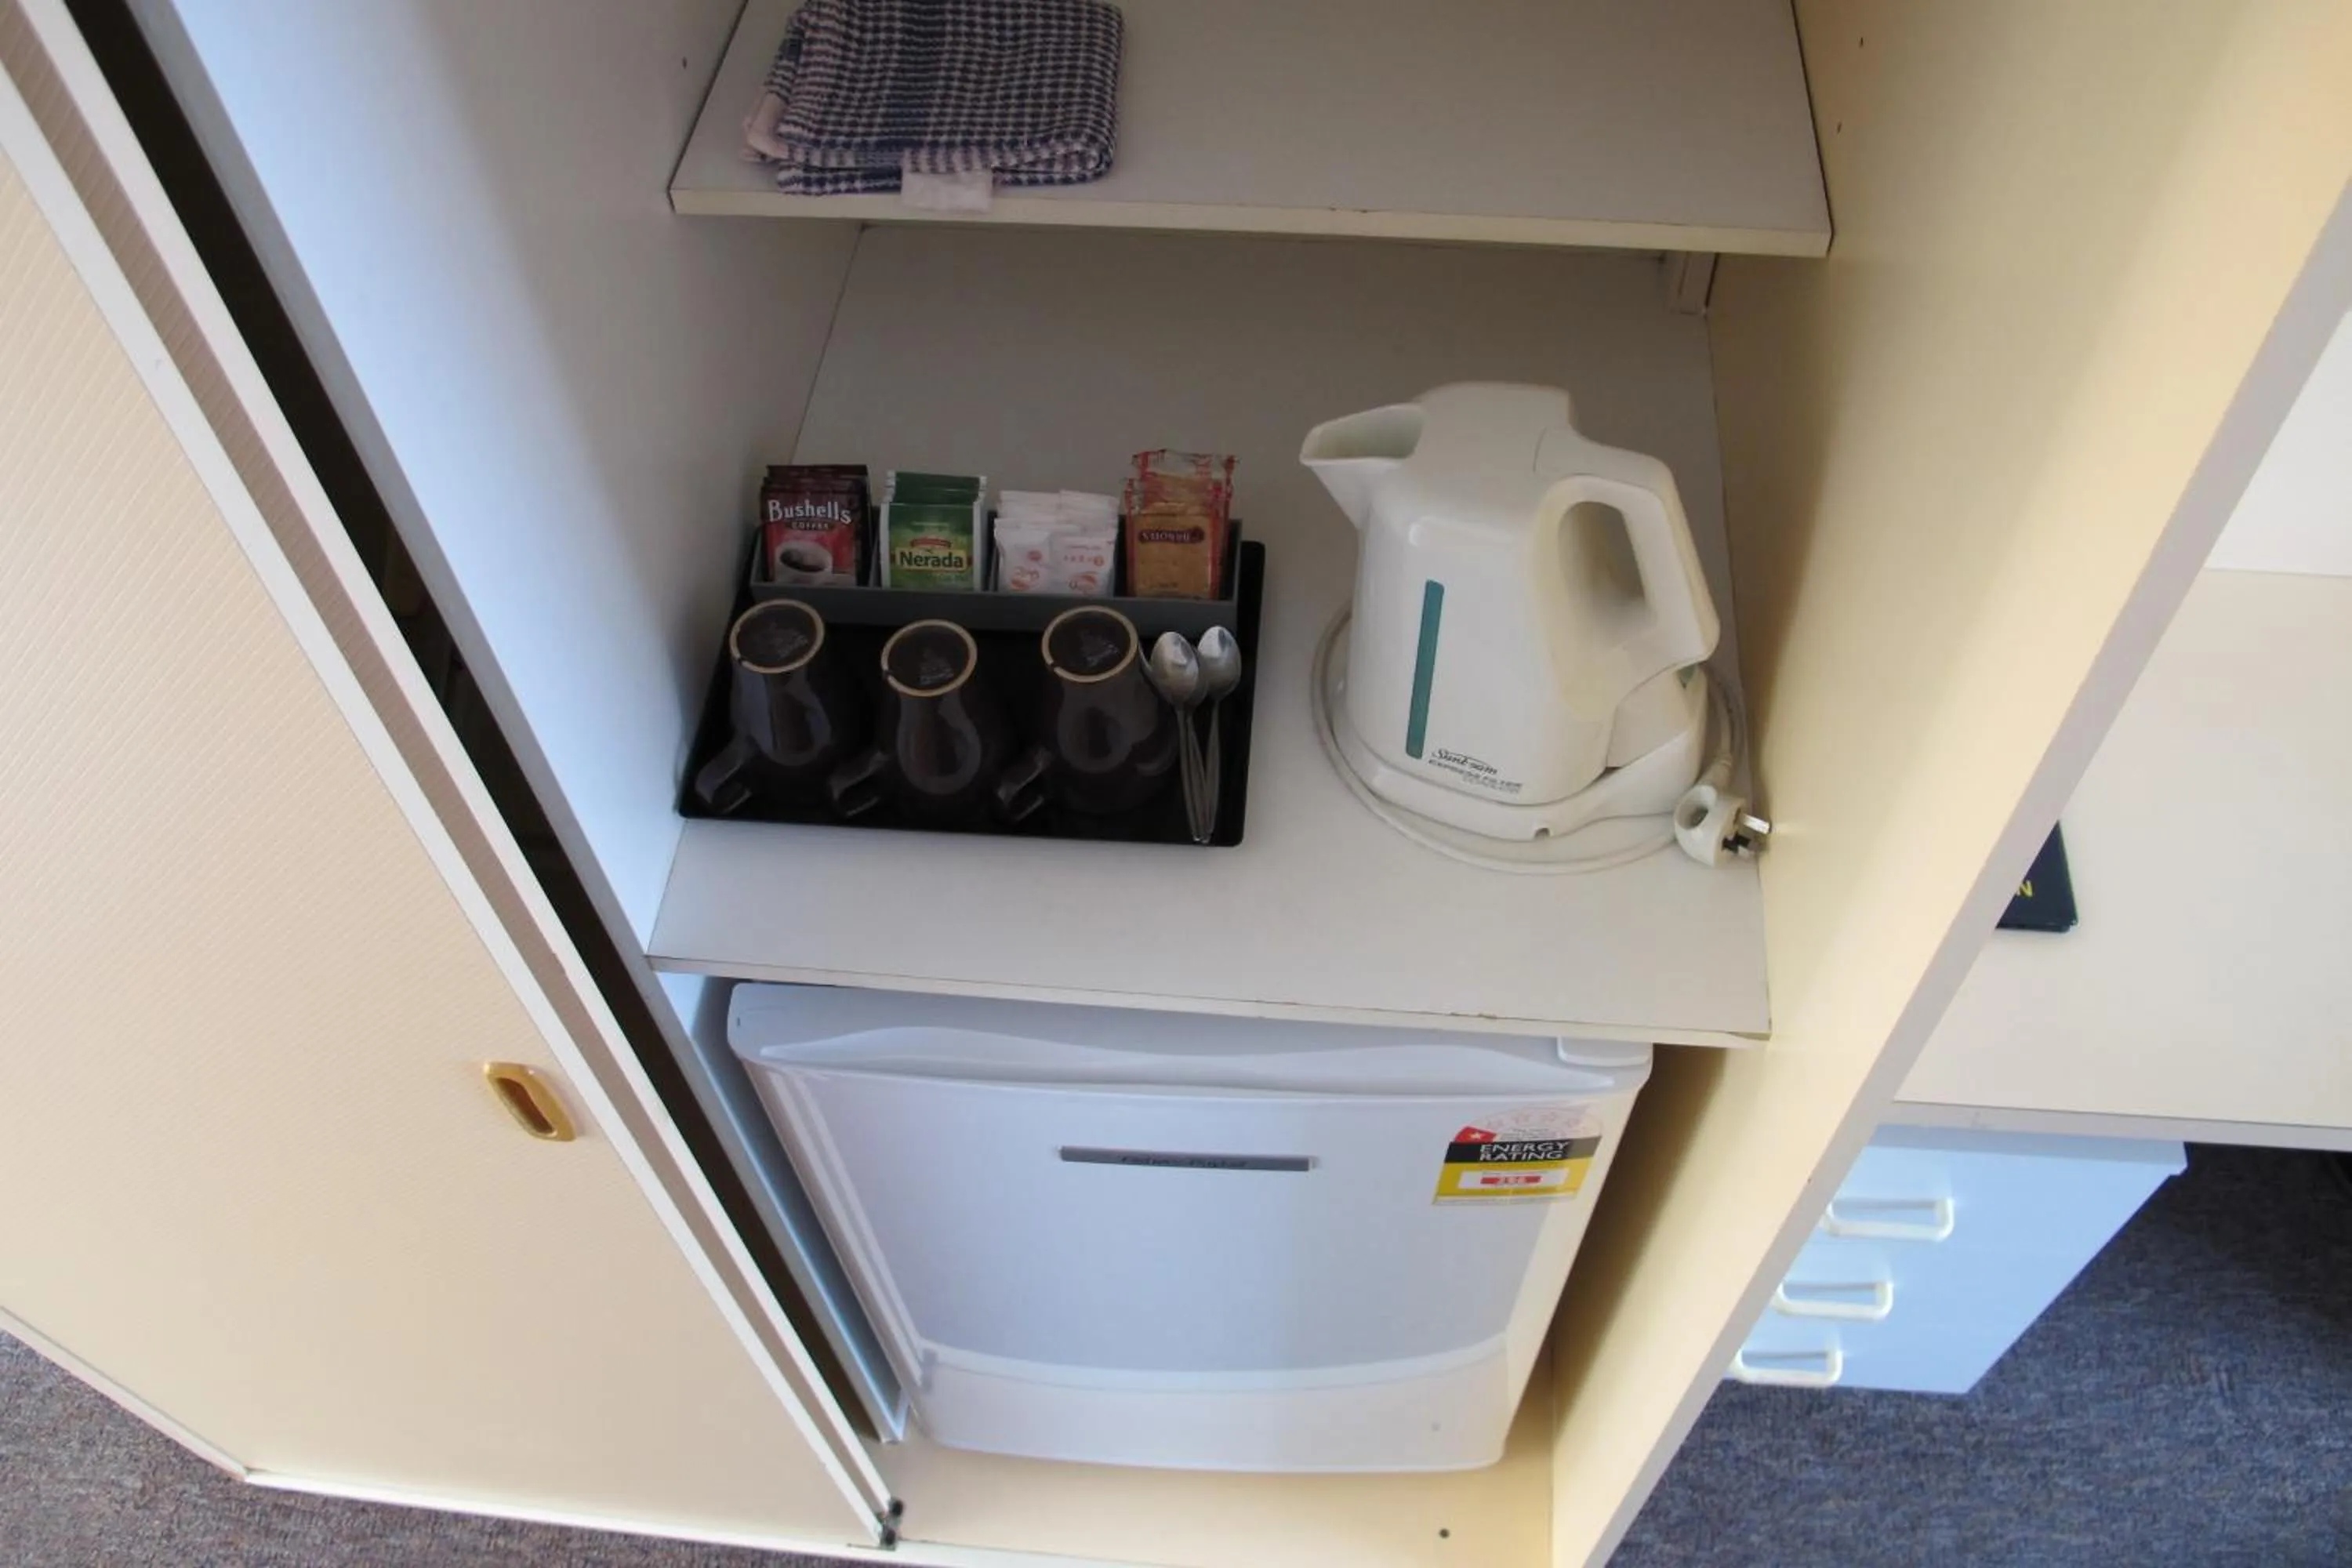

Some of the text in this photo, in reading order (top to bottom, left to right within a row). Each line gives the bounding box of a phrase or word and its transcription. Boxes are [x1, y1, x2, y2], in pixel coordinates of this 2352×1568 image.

[767, 498, 852, 524] Bushells
[900, 550, 964, 568] Nerada
[1479, 1142, 1569, 1153] ENERGY
[1479, 1151, 1563, 1162] RATING
